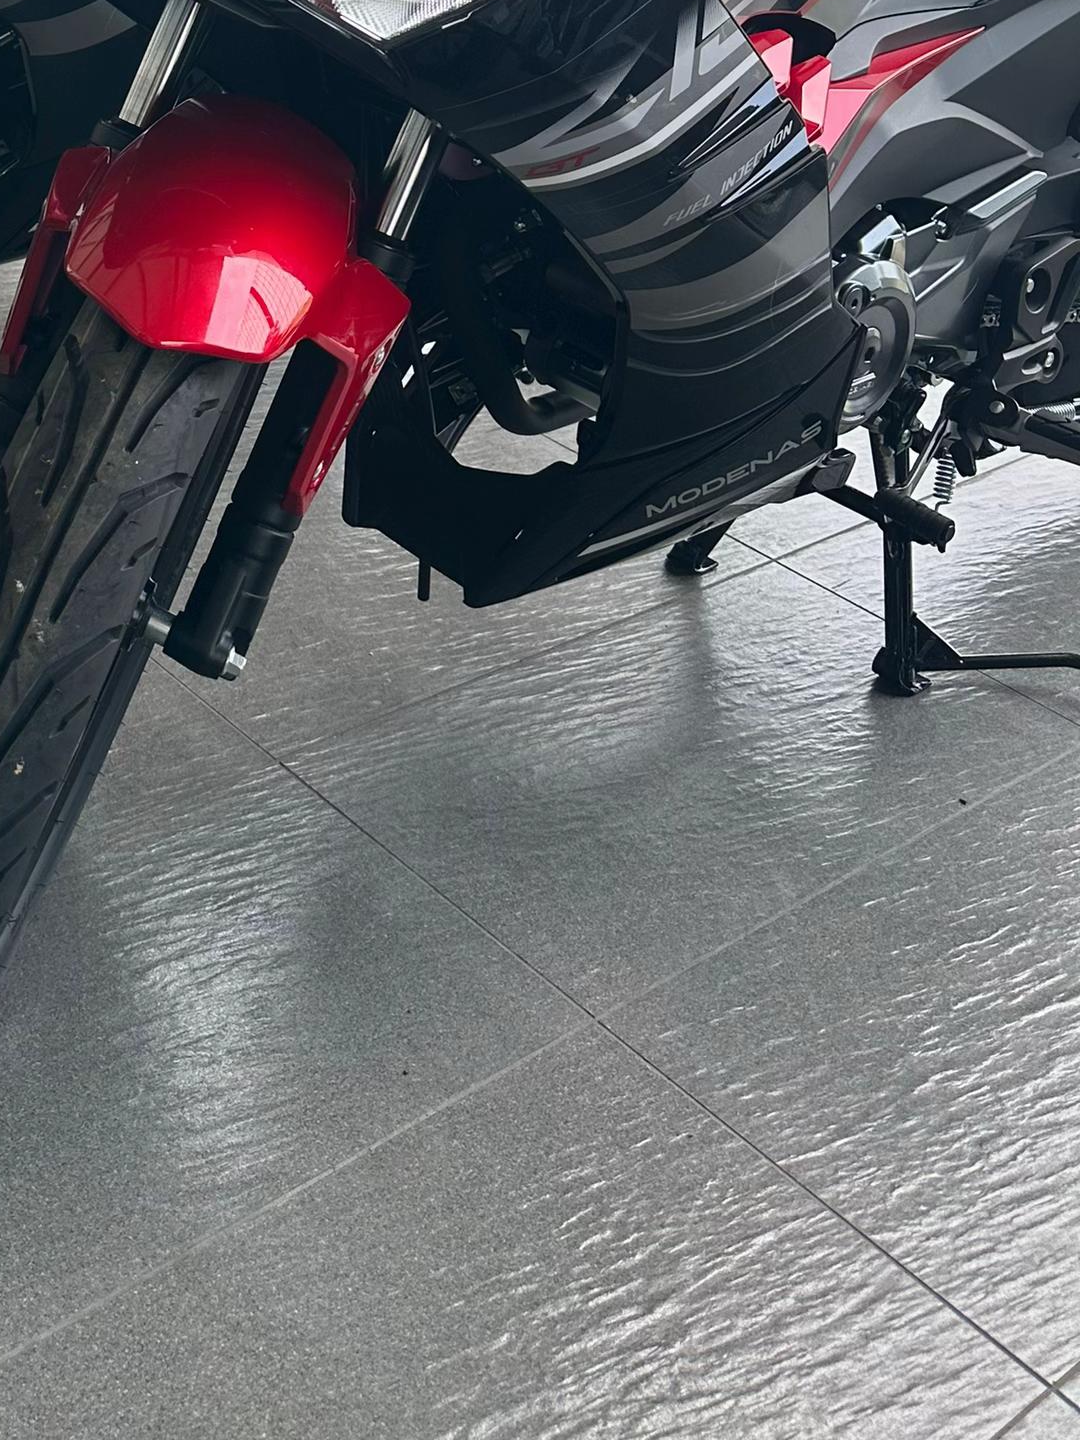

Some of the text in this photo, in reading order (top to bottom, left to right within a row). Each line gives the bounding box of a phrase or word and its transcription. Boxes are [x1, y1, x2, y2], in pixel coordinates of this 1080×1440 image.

[526, 145, 601, 177] GT
[663, 120, 793, 227] FUEL INJECTION
[646, 420, 823, 518] MODENAS
